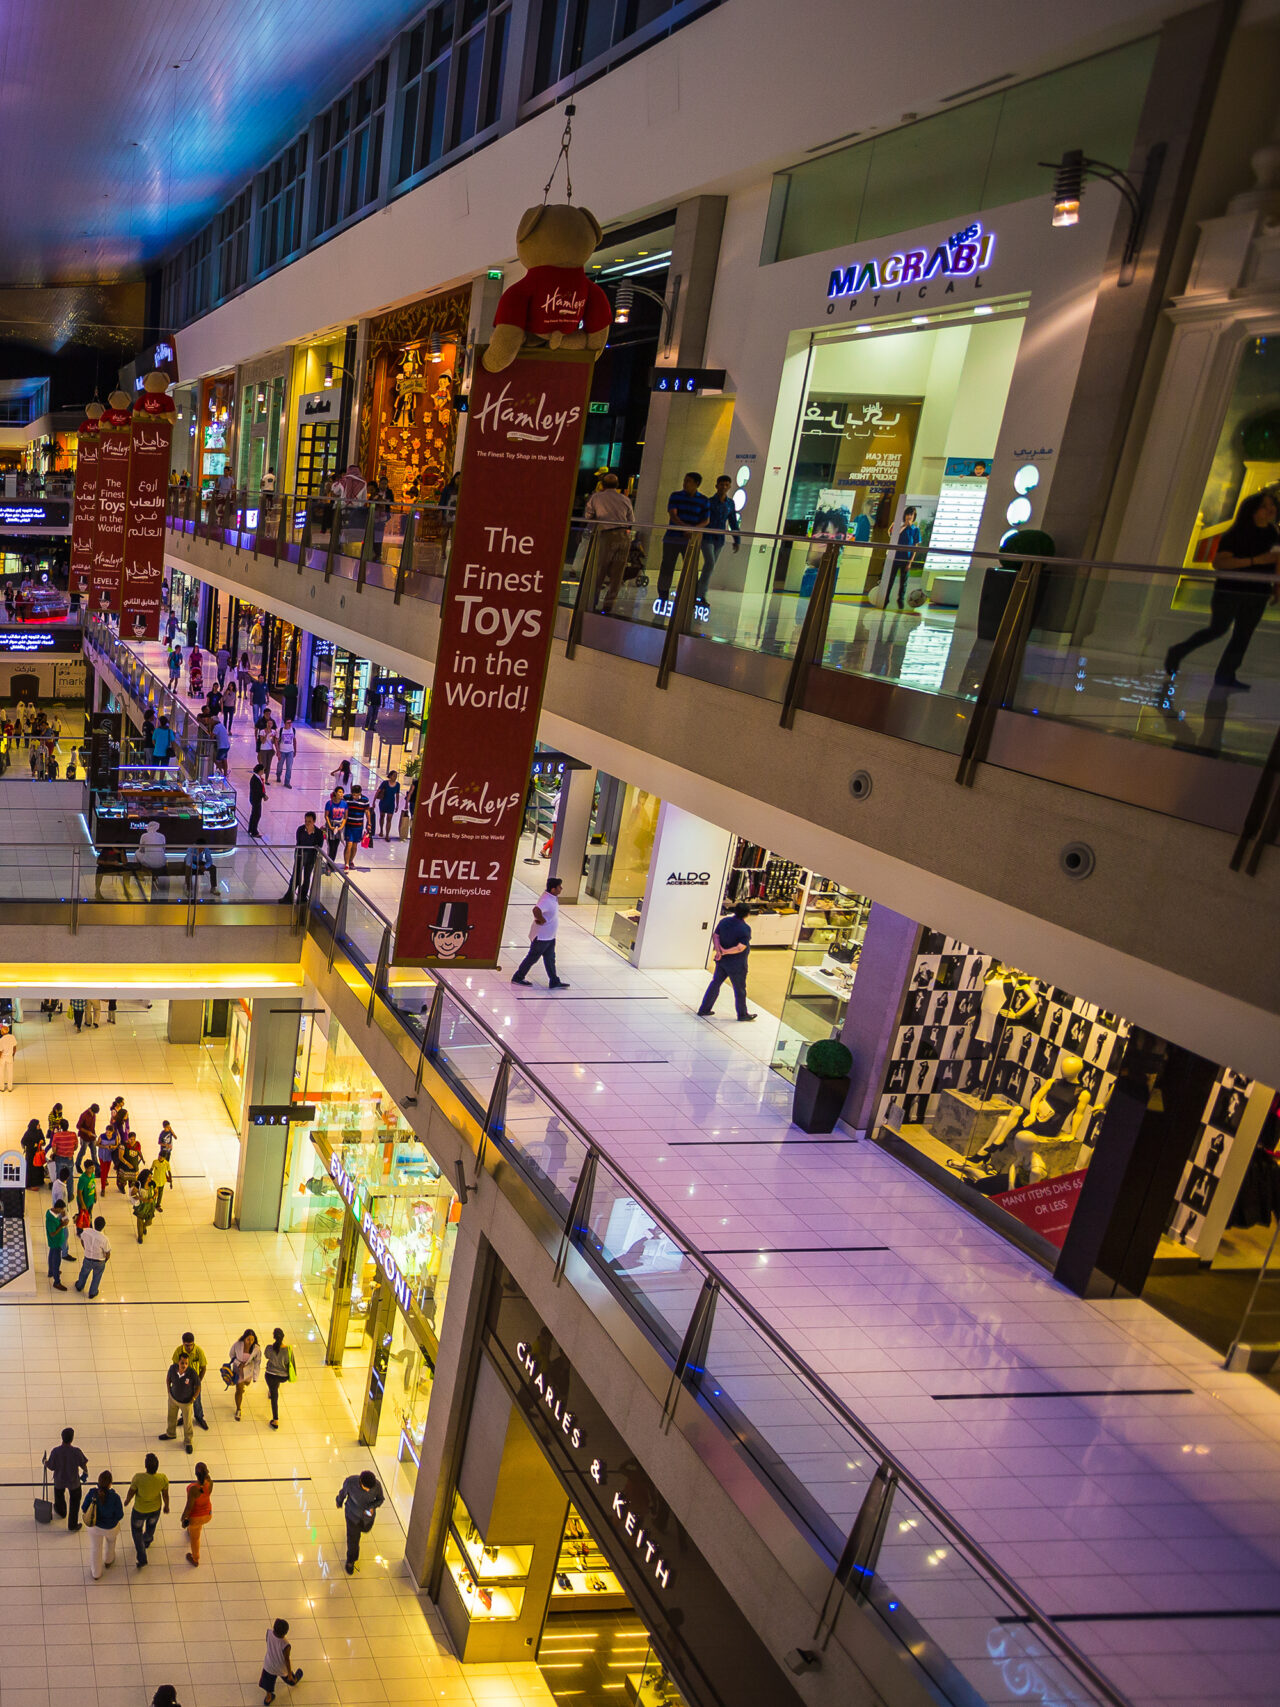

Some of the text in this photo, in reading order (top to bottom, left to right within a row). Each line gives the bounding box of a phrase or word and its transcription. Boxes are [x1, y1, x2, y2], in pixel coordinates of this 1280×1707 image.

[826, 233, 995, 299] MAGRABI
[826, 276, 983, 315] OPTICAL
[472, 380, 580, 446] Hamleys
[101, 489, 125, 498] Finest
[106, 478, 122, 487] The
[99, 499, 126, 514] Toys
[99, 514, 123, 523] in the
[98, 524, 124, 534] World!
[483, 527, 534, 555] The
[93, 577, 120, 586] LEVEL 2
[462, 564, 544, 593] Finest
[454, 595, 542, 647] Toys
[453, 651, 529, 677] in the
[59, 677, 84, 686] mark
[444, 682, 529, 713] World!
[420, 772, 521, 827] Hamleys
[418, 859, 500, 881] LEVEL 2
[667, 871, 711, 881] ALDO
[439, 886, 492, 897] HamleysUae
[1001, 1192, 1027, 1207] MANY
[1027, 1186, 1053, 1200] ITEMS
[1053, 1180, 1072, 1194] DHS
[1034, 1199, 1069, 1215] OR LESS
[362, 1211, 413, 1312] PERONI
[516, 1341, 670, 1590] CHARLES & KEITH
